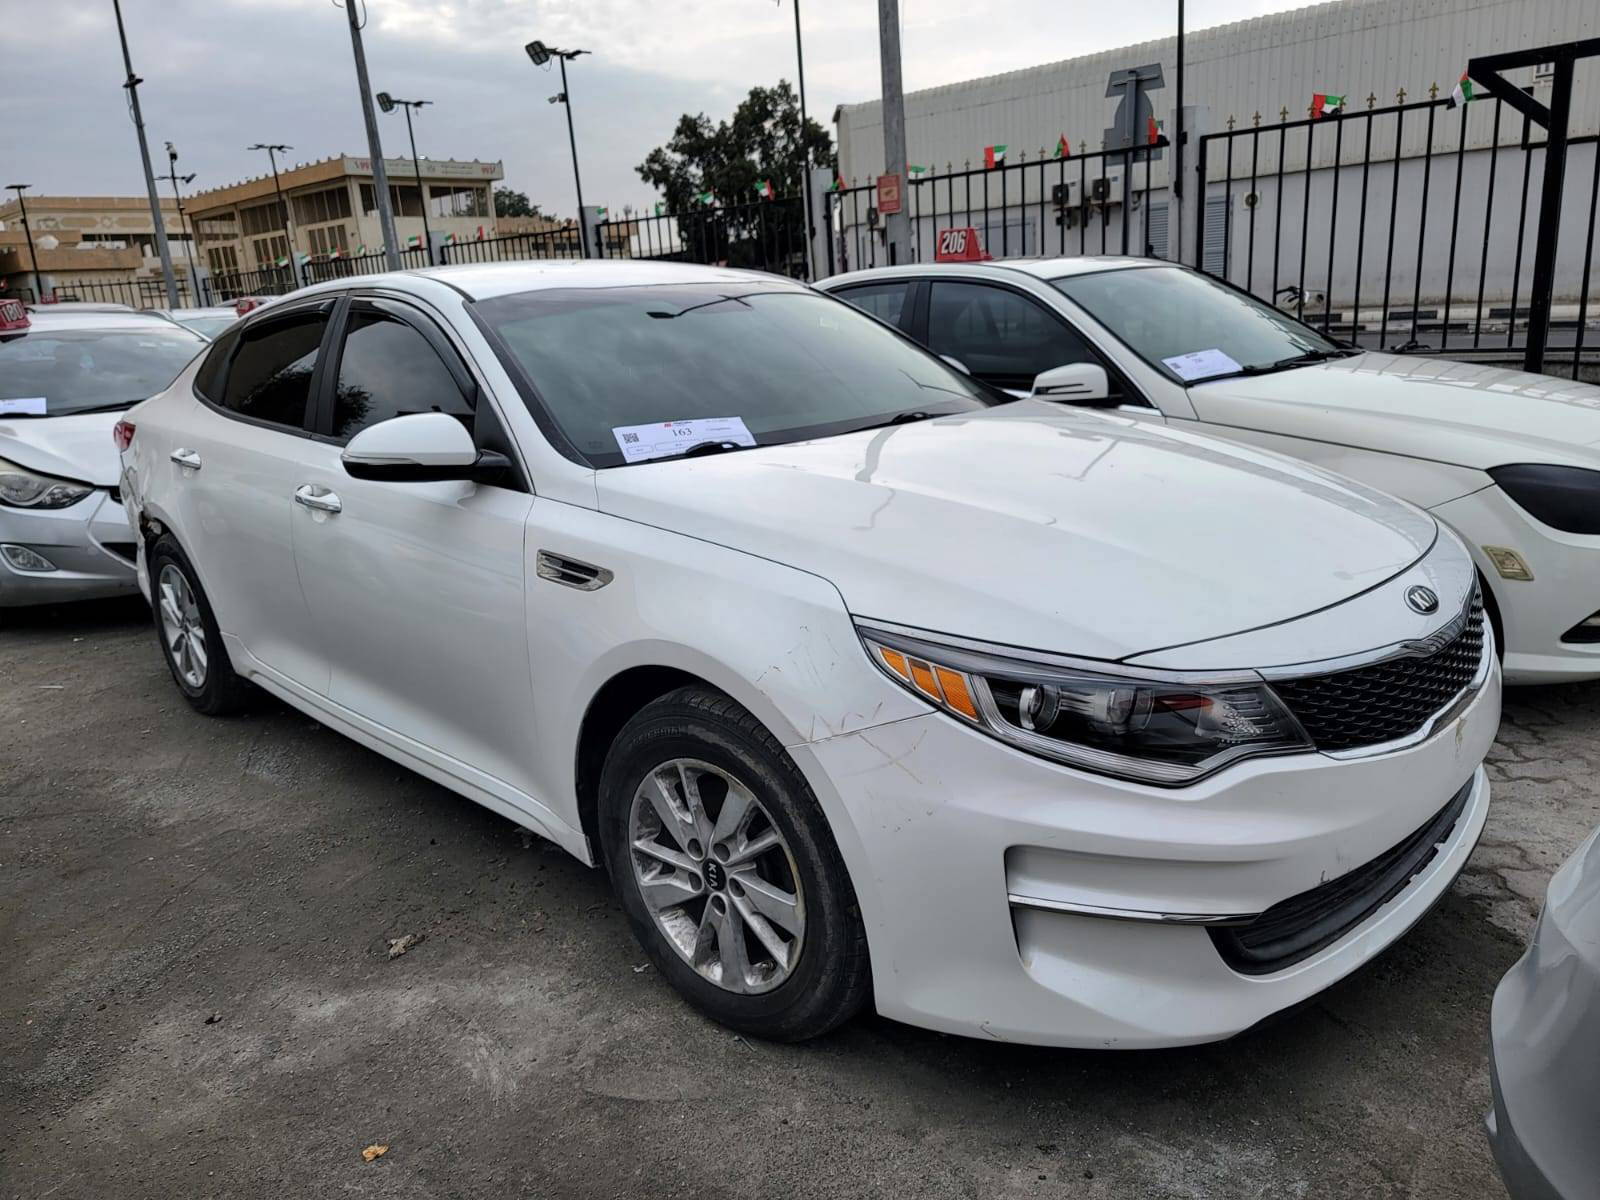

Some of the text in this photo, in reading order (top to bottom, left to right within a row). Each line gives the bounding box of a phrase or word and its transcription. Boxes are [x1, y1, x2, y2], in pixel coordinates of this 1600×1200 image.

[941, 231, 966, 254] 206
[1, 302, 24, 323] 180
[672, 428, 692, 437] 163
[708, 863, 718, 887] KIA
